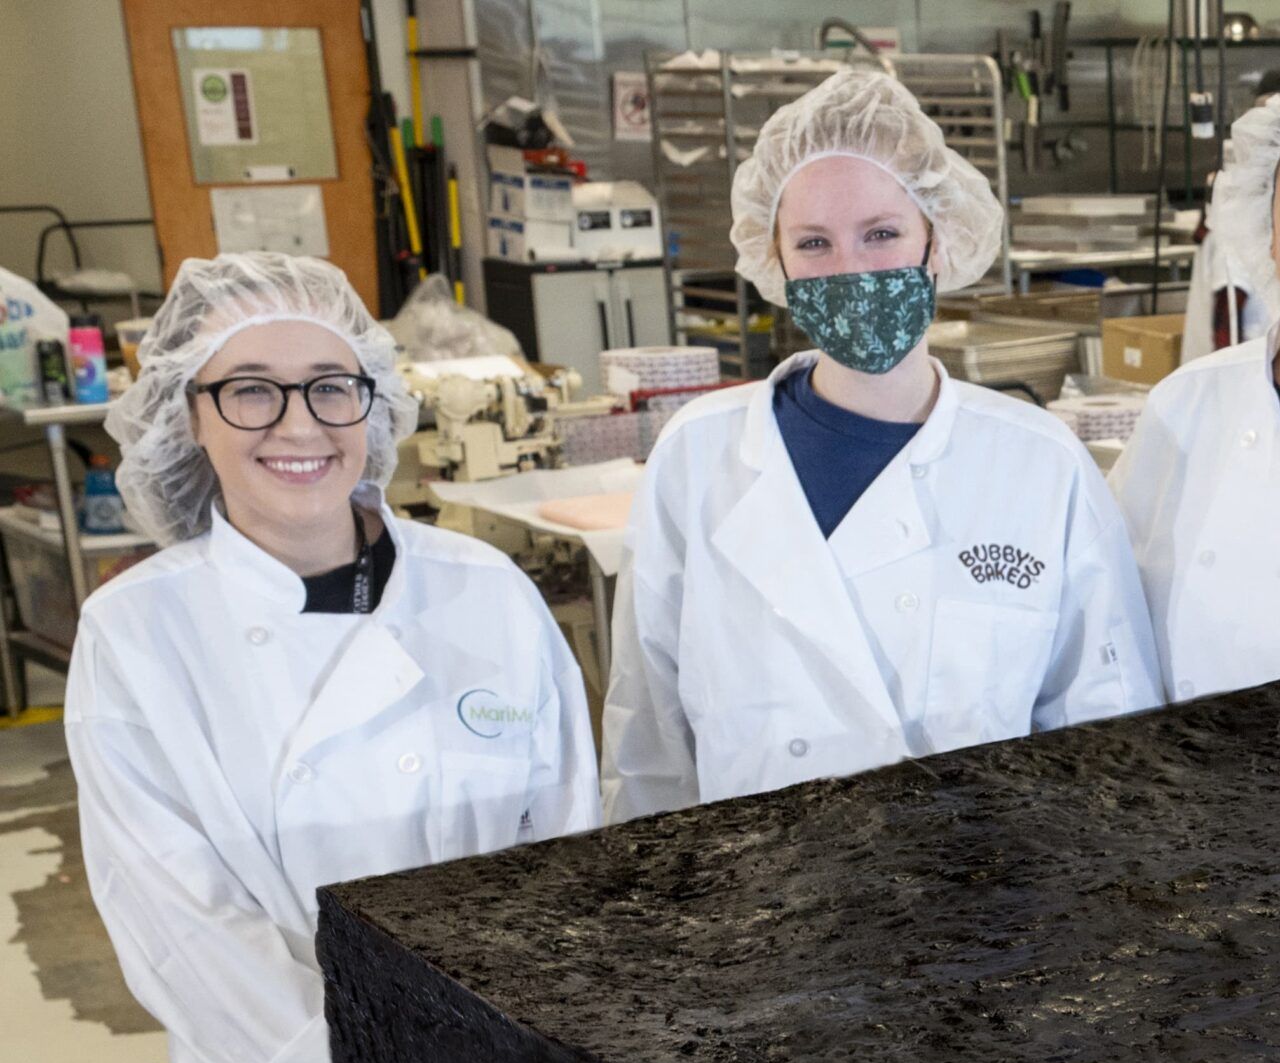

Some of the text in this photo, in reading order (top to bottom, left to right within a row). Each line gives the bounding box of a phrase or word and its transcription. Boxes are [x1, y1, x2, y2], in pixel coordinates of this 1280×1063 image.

[958, 543, 1045, 577] BUBBY'S
[971, 561, 1031, 589] BAKED
[469, 704, 533, 724] MariM
